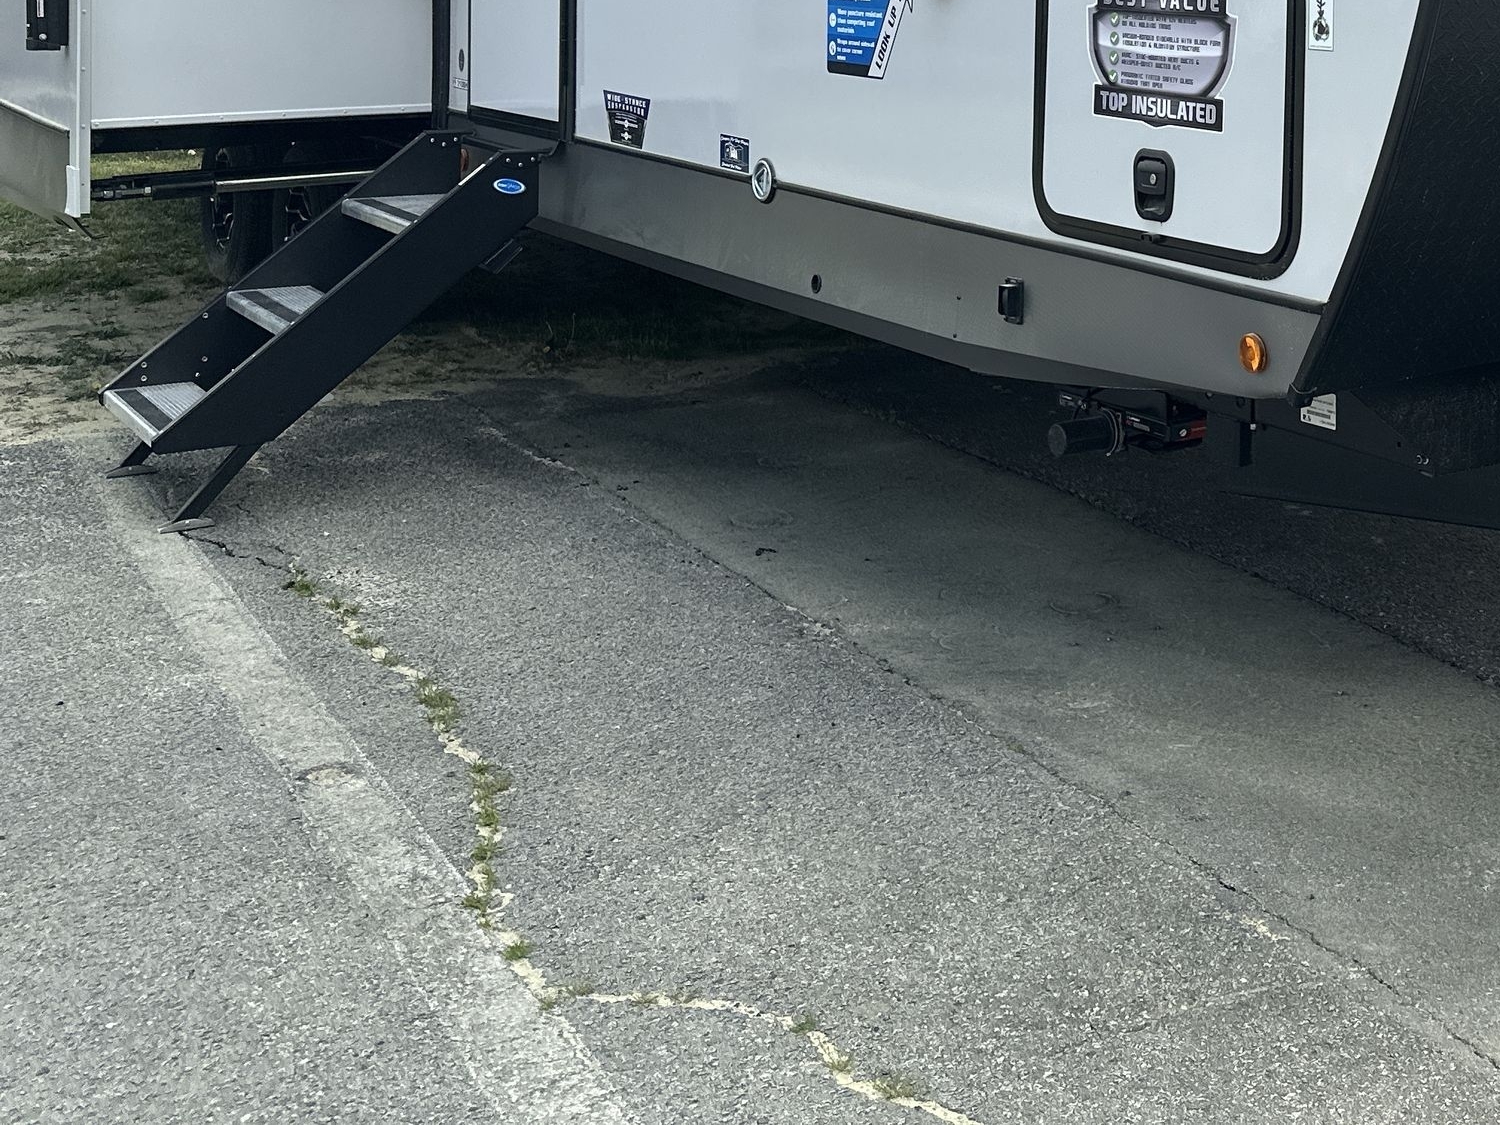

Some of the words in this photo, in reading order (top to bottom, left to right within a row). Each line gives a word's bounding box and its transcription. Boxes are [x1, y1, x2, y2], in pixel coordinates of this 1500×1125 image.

[875, 32, 891, 70] LOOK
[888, 6, 896, 28] UP
[1100, 91, 1128, 112] TOP
[1131, 94, 1217, 124] INSULATED
